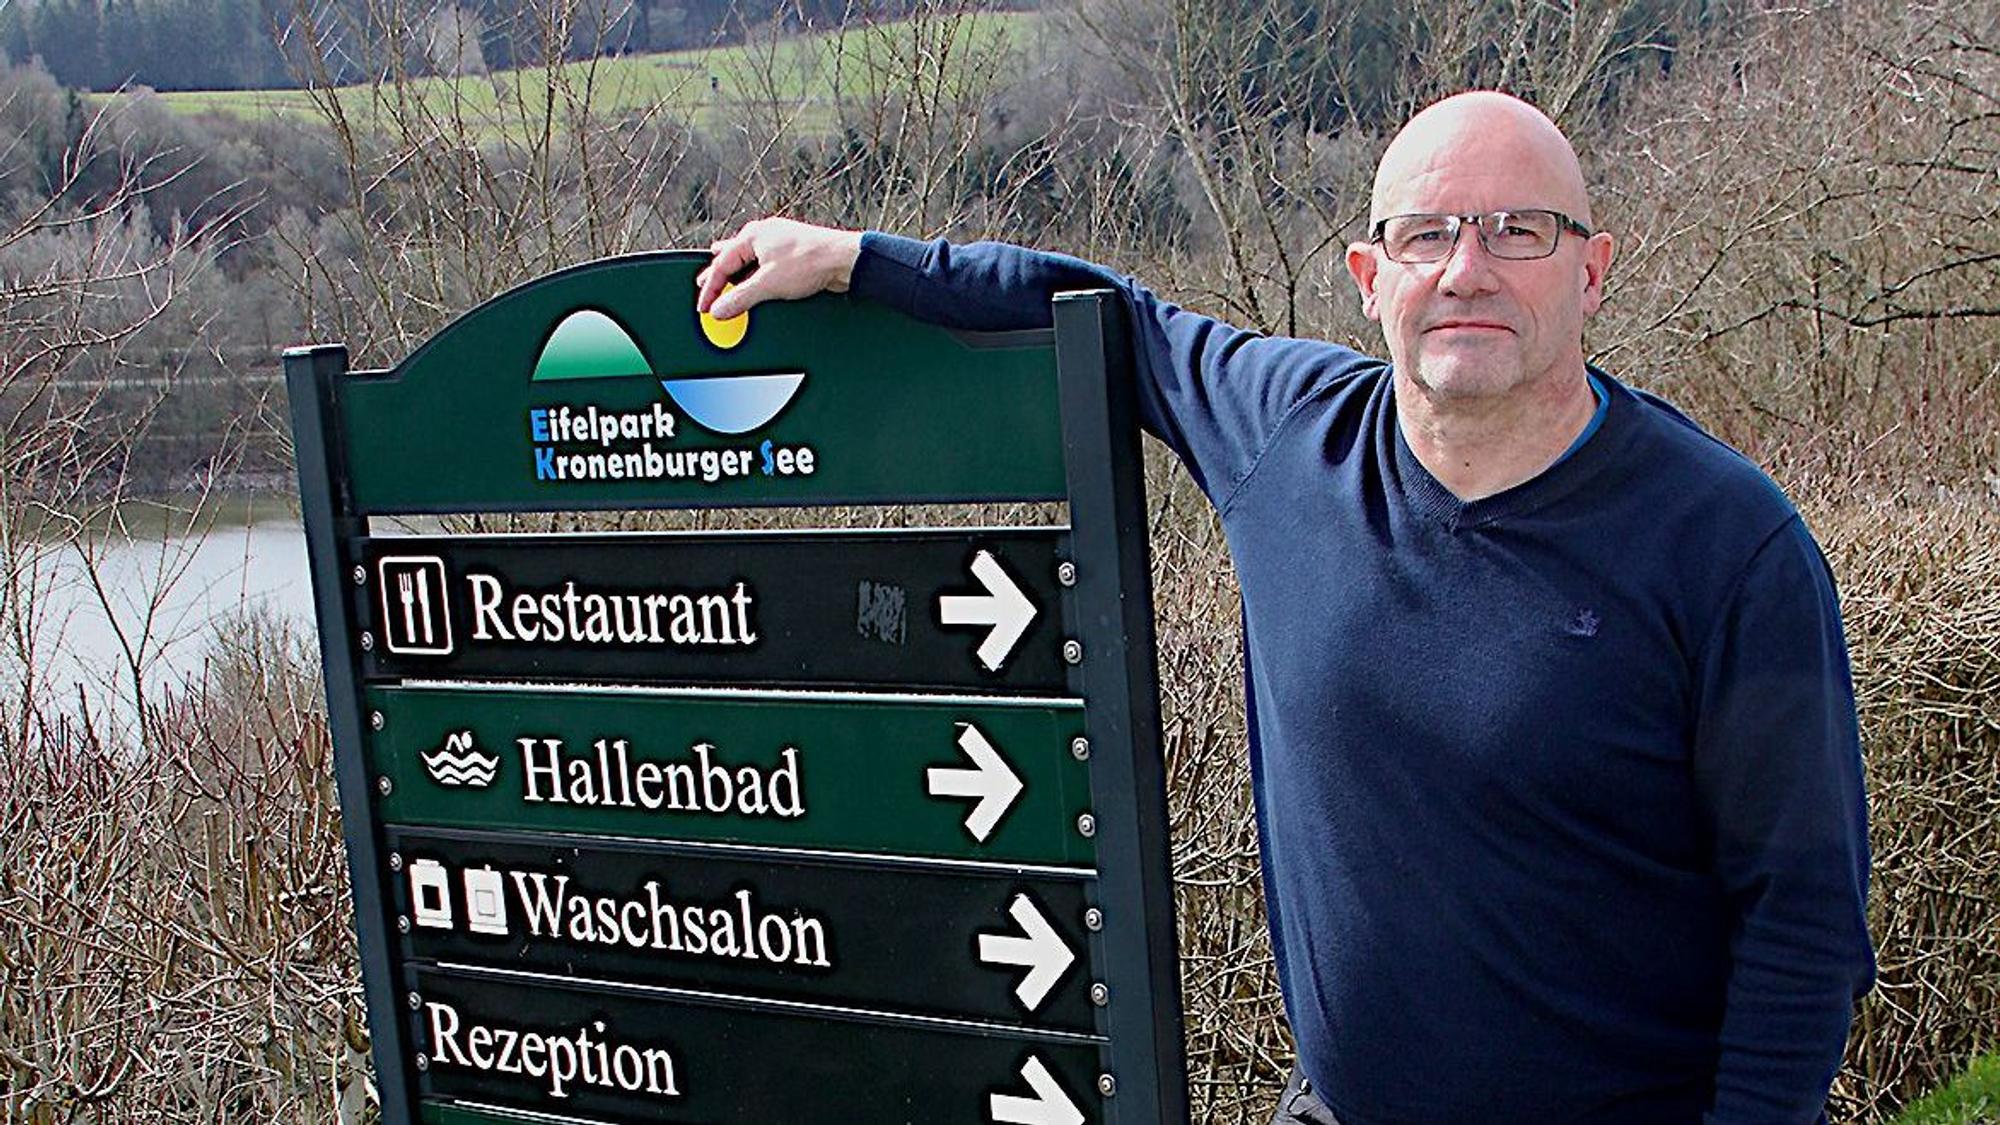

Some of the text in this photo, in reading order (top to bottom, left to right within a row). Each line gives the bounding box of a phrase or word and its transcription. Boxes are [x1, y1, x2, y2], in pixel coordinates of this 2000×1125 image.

[530, 403, 675, 446] Eifelpark
[535, 439, 814, 482] Kronenburger See
[466, 574, 757, 645] Restaurant
[517, 738, 805, 818] Hallenbad
[510, 871, 831, 967] Waschsalon
[425, 1003, 680, 1097] Rezeption
